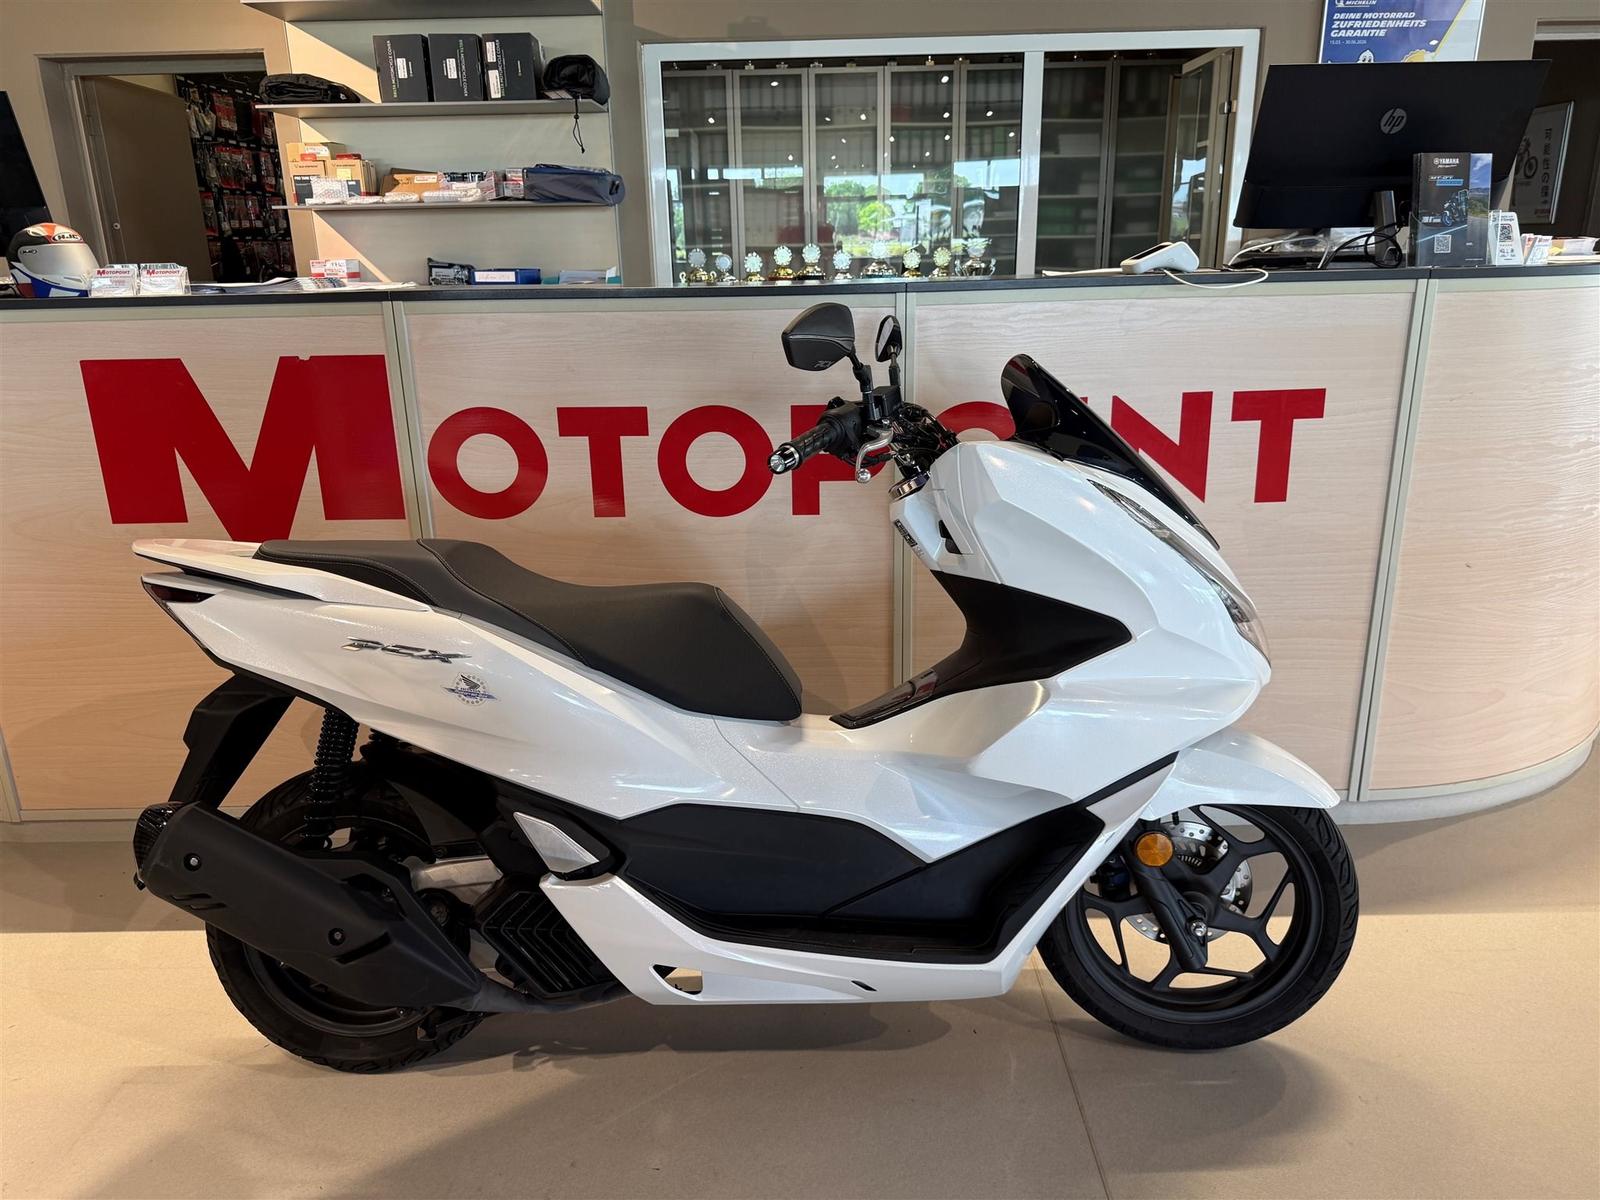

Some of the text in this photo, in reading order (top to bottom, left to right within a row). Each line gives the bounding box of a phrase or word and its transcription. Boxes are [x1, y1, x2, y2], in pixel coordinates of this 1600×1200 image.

[1332, 20, 1427, 28] ZUFRIEDENHEITS
[1330, 29, 1387, 37] GARANTIE
[1382, 108, 1406, 134] hp
[80, 354, 1326, 543] MOTOPNT
